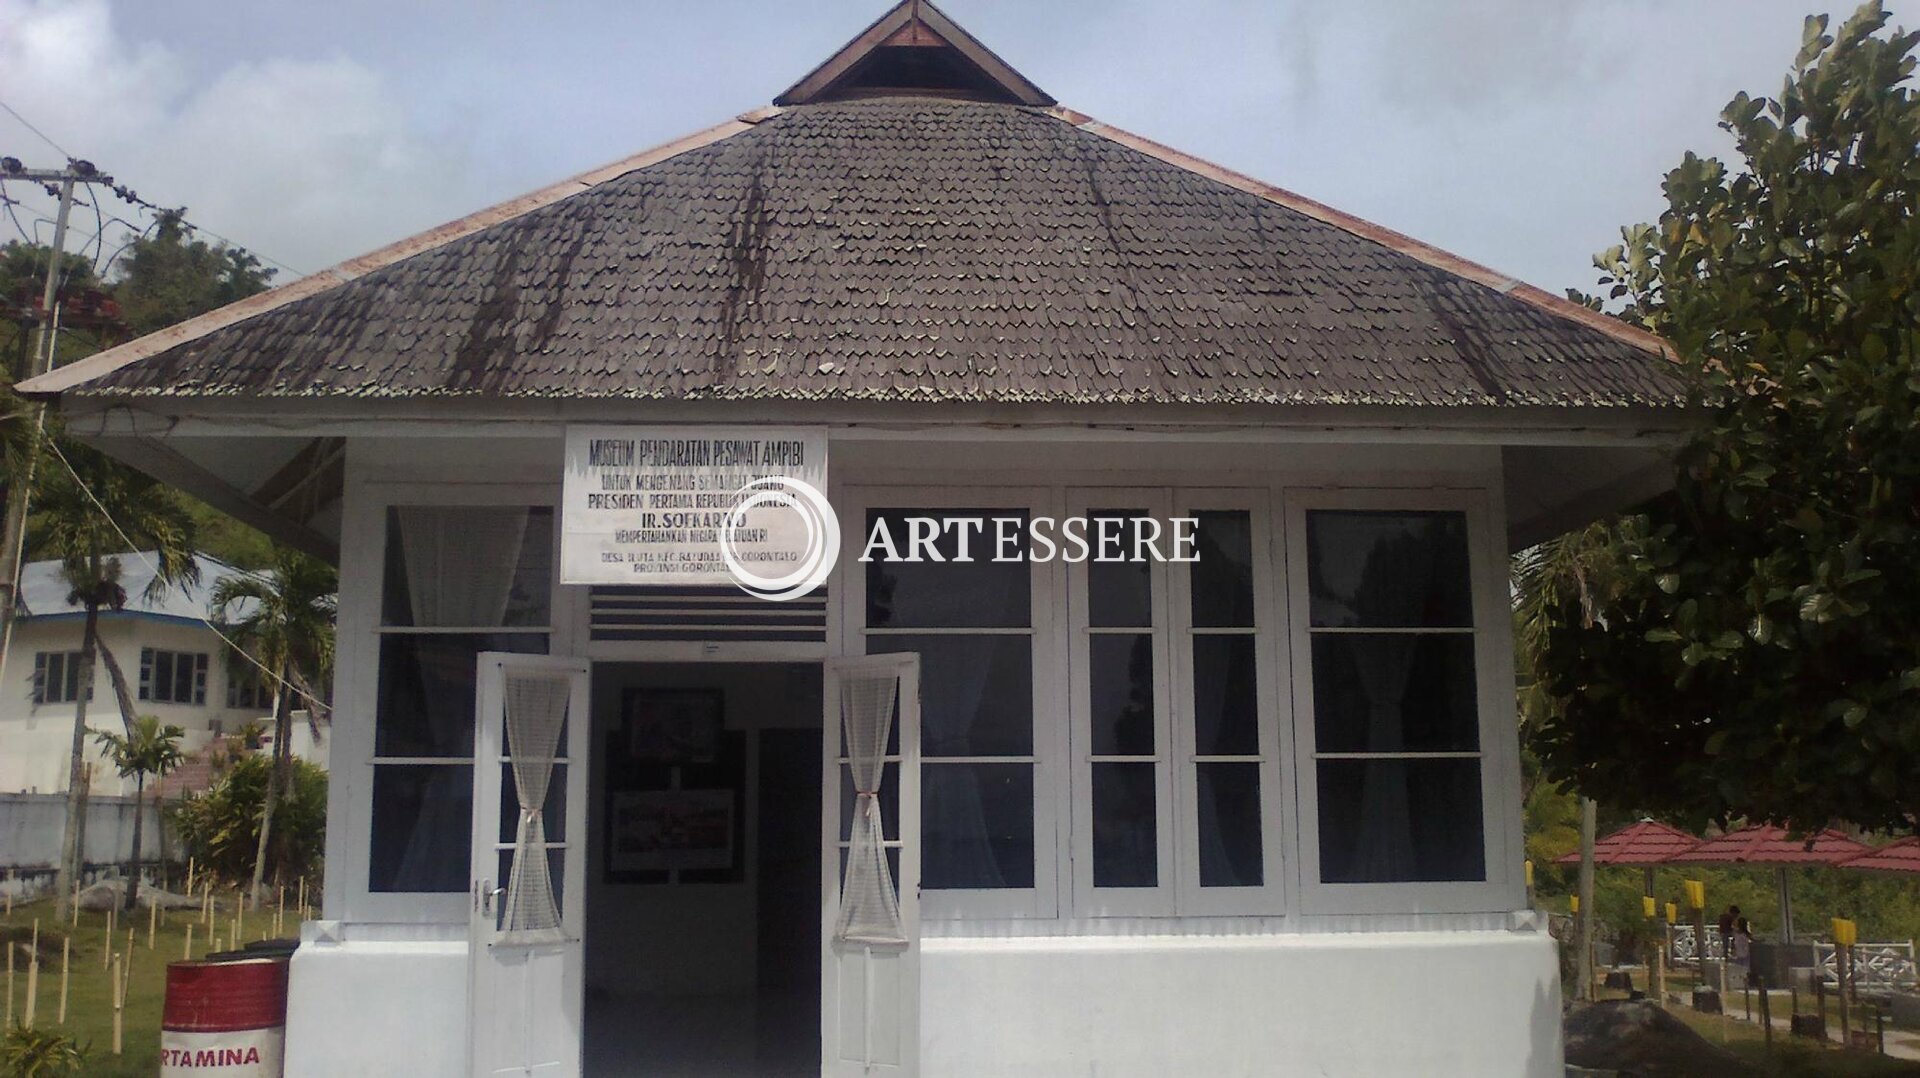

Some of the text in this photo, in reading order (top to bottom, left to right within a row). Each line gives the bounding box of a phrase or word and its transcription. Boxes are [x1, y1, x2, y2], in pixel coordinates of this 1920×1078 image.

[589, 439, 804, 467] MUSEUM PENDARATAN PESAWAT AMPIBI
[602, 474, 631, 490] UNTUK
[636, 474, 695, 490] MENGENANG
[588, 494, 643, 509] PRESIDEN
[650, 494, 693, 508] PERTAMA
[696, 494, 739, 508] REPUBLIK
[681, 562, 734, 573] GORONTAL
